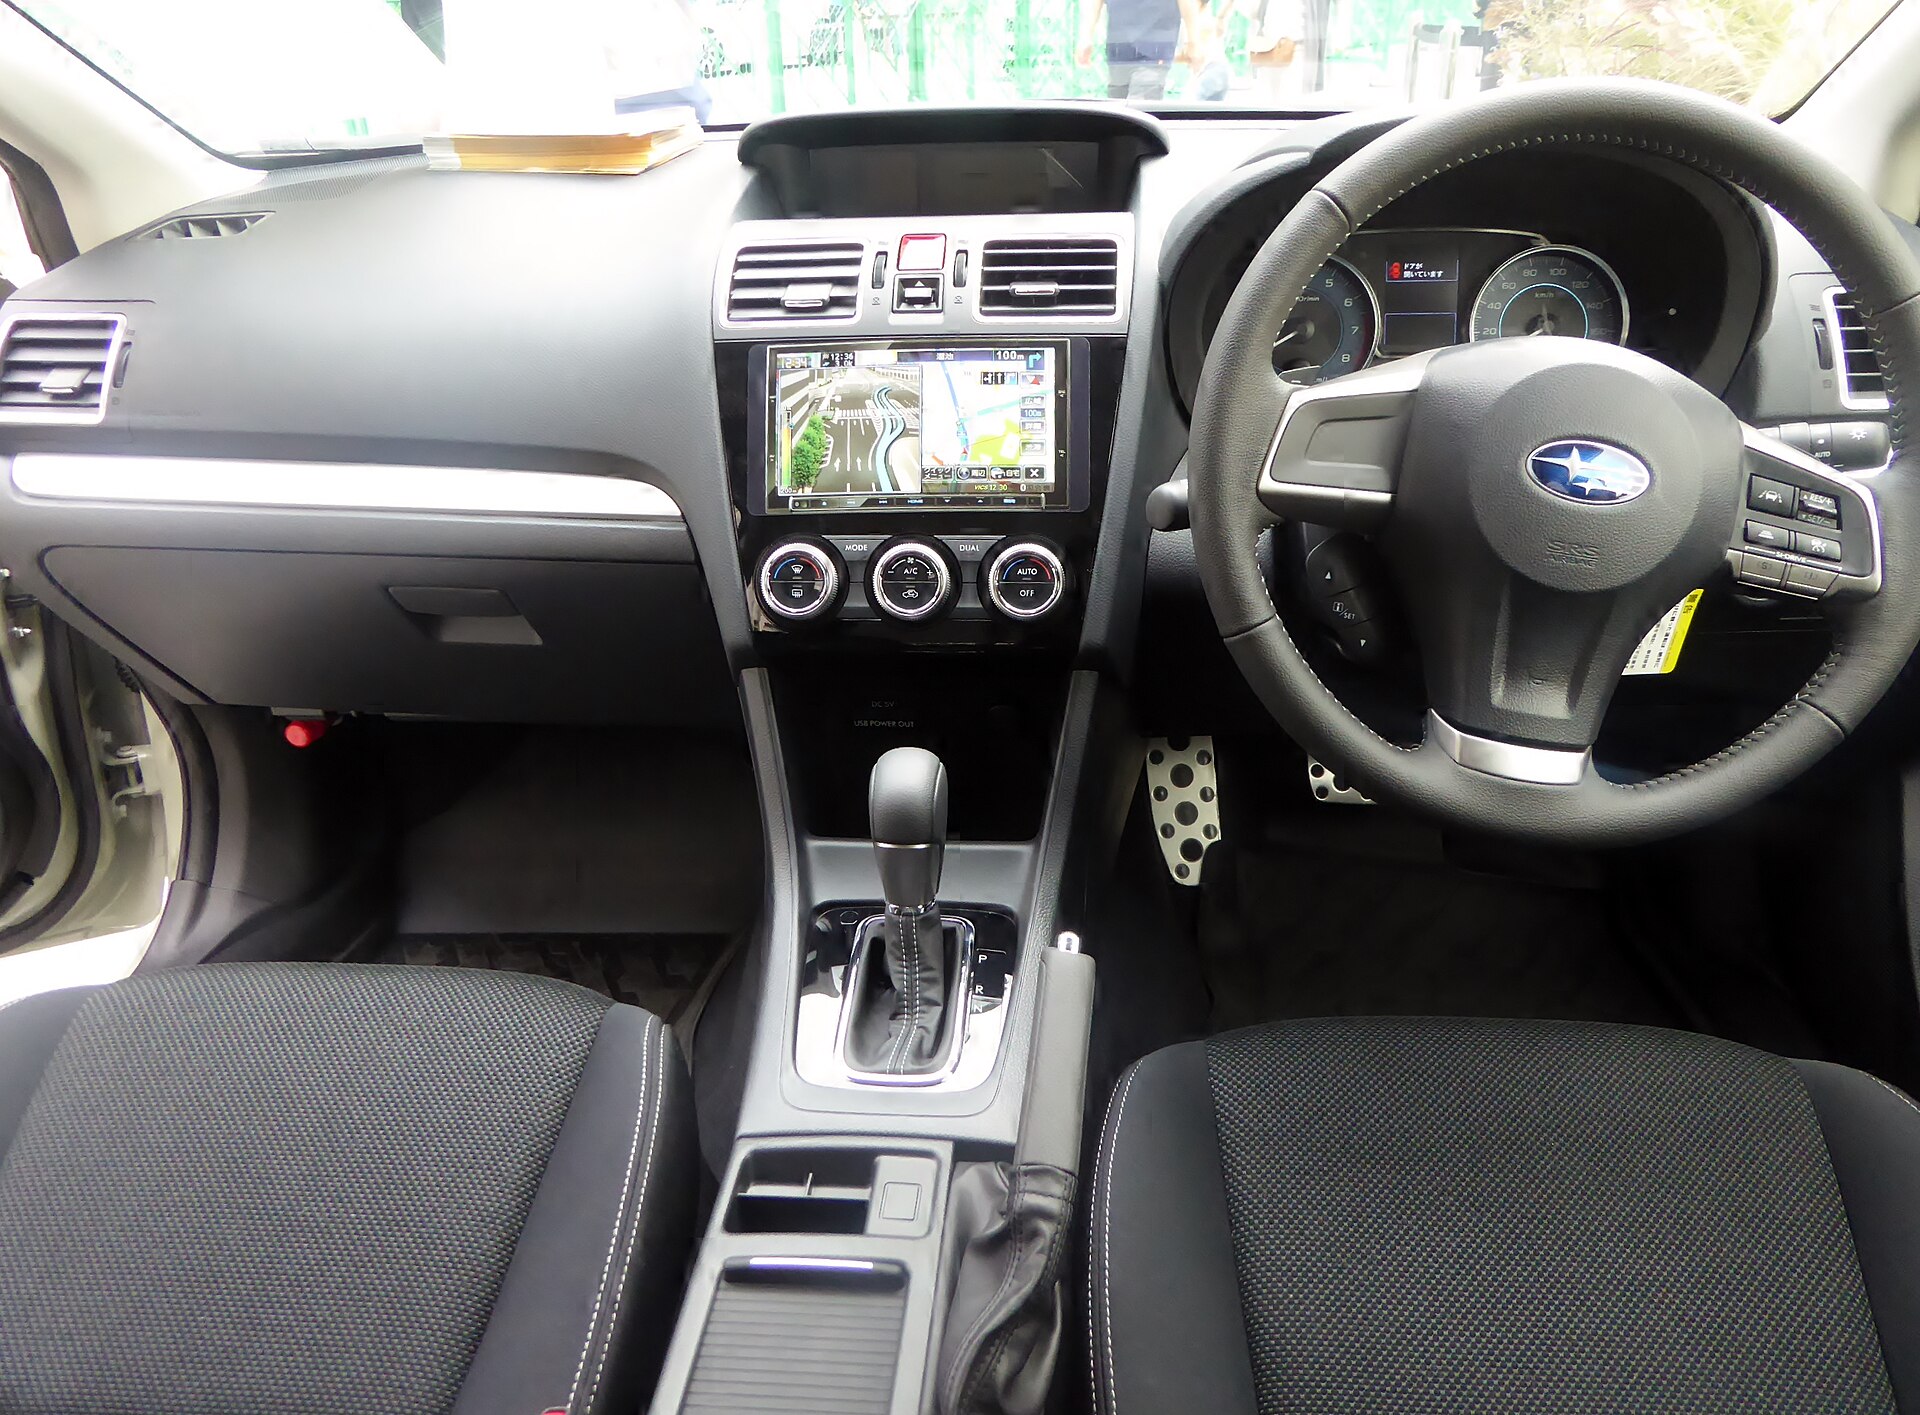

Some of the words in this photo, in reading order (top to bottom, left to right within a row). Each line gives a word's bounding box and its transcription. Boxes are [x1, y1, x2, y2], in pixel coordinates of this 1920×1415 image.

[1522, 268, 1538, 277] 80
[1549, 268, 1567, 276] 100
[1325, 279, 1334, 288] 5
[1501, 282, 1517, 290] 60
[1572, 281, 1590, 289] 120
[1534, 291, 1555, 299] km/h
[1344, 298, 1353, 307] 6
[1487, 302, 1502, 310] 40
[1351, 326, 1360, 335] 7
[1482, 327, 1497, 335] 20
[996, 350, 1025, 360] 100m
[1341, 354, 1351, 363] 8
[1815, 451, 1831, 459] AUTO
[959, 544, 980, 552] DUAL
[1019, 589, 1035, 597] OFF
[871, 700, 882, 708] DC
[884, 700, 895, 708] 5V
[898, 720, 914, 728] OUT
[978, 954, 988, 963] P
[975, 984, 984, 994] R
[973, 1004, 983, 1013] N
